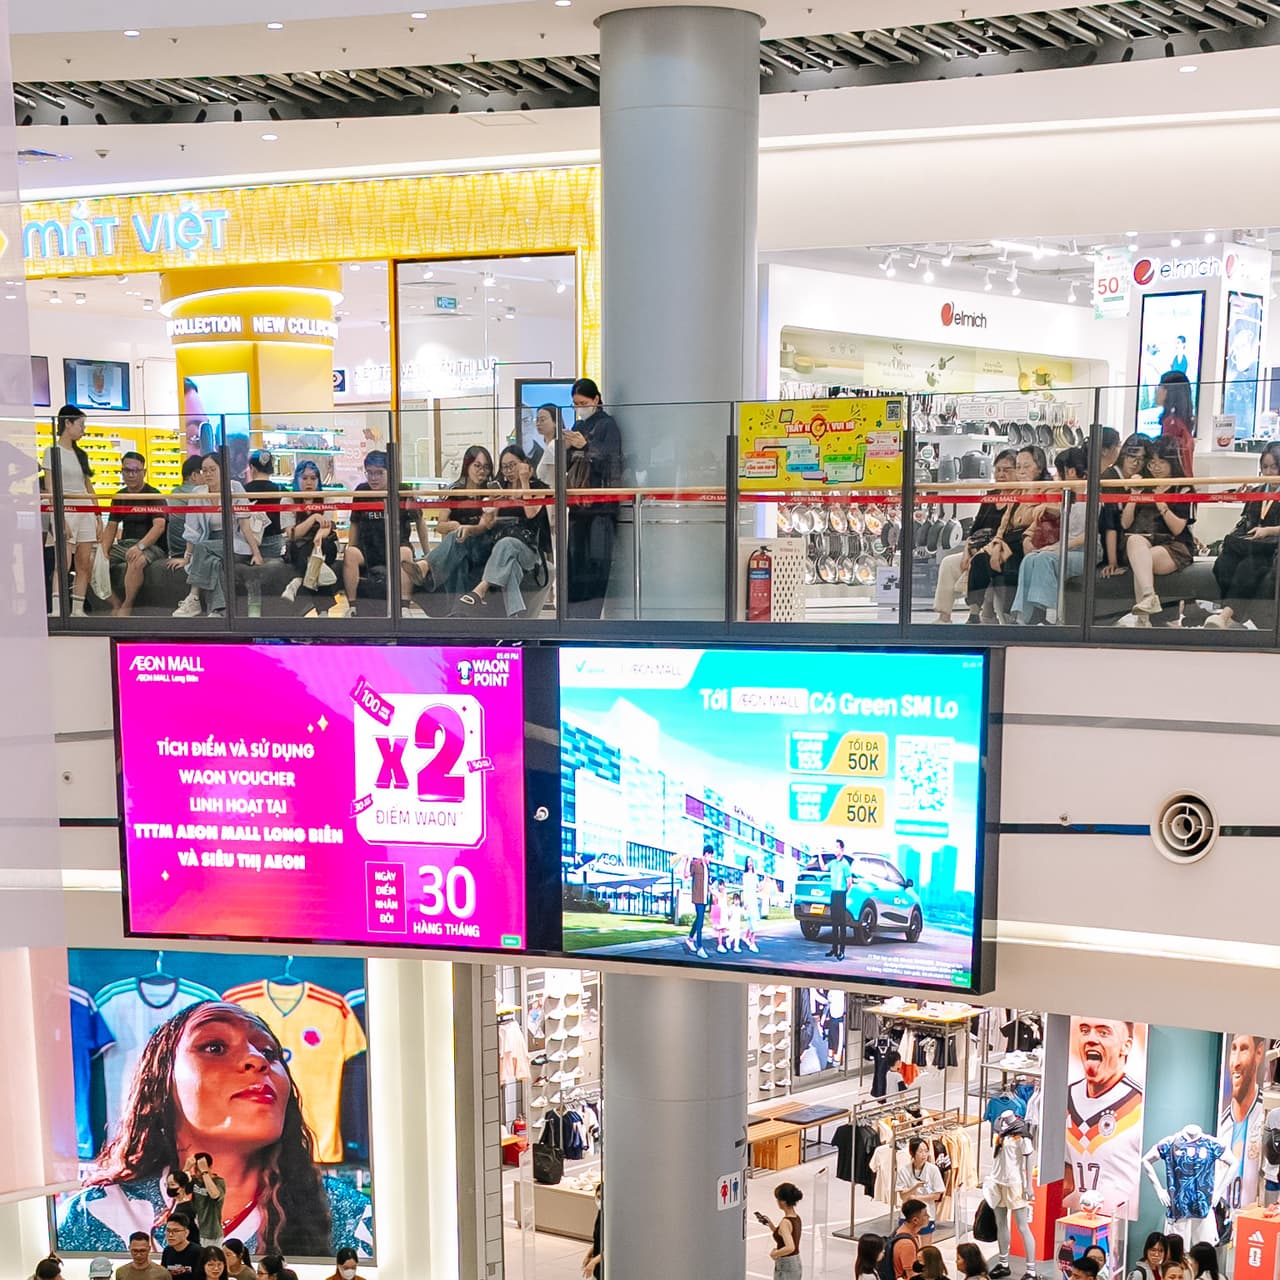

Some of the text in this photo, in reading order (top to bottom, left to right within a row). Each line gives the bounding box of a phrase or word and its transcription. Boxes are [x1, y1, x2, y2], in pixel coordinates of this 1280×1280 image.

[1160, 256, 1220, 280] elmich
[173, 316, 242, 336] COLLECTION
[253, 317, 286, 334] NEW
[954, 312, 987, 328] elmich
[168, 656, 204, 671] MALL
[472, 660, 510, 673] WAON
[473, 673, 510, 687] POINT
[809, 692, 836, 713] Có
[839, 696, 898, 717] Green
[900, 695, 932, 718] SM
[157, 734, 315, 762] TÍCH ĐIỂM VÀ SỬ DỤNG
[848, 738, 879, 752] TỐI ĐA
[848, 753, 880, 772] 50K
[179, 769, 296, 787] WAON VOUCHER
[847, 790, 877, 804] TỐI ĐA
[190, 797, 287, 818] LINH HOẠT TẠI
[376, 805, 457, 826] ĐIỂM WAON
[847, 805, 878, 824] 50K
[134, 823, 344, 844] TTTM AEON MALL LONG BIÊN
[178, 848, 306, 872] VÀ SIÊU THỊ AEON
[418, 865, 476, 919] 30
[413, 920, 480, 937] HÀNG THÁNG
[1076, 1162, 1101, 1193] 17
